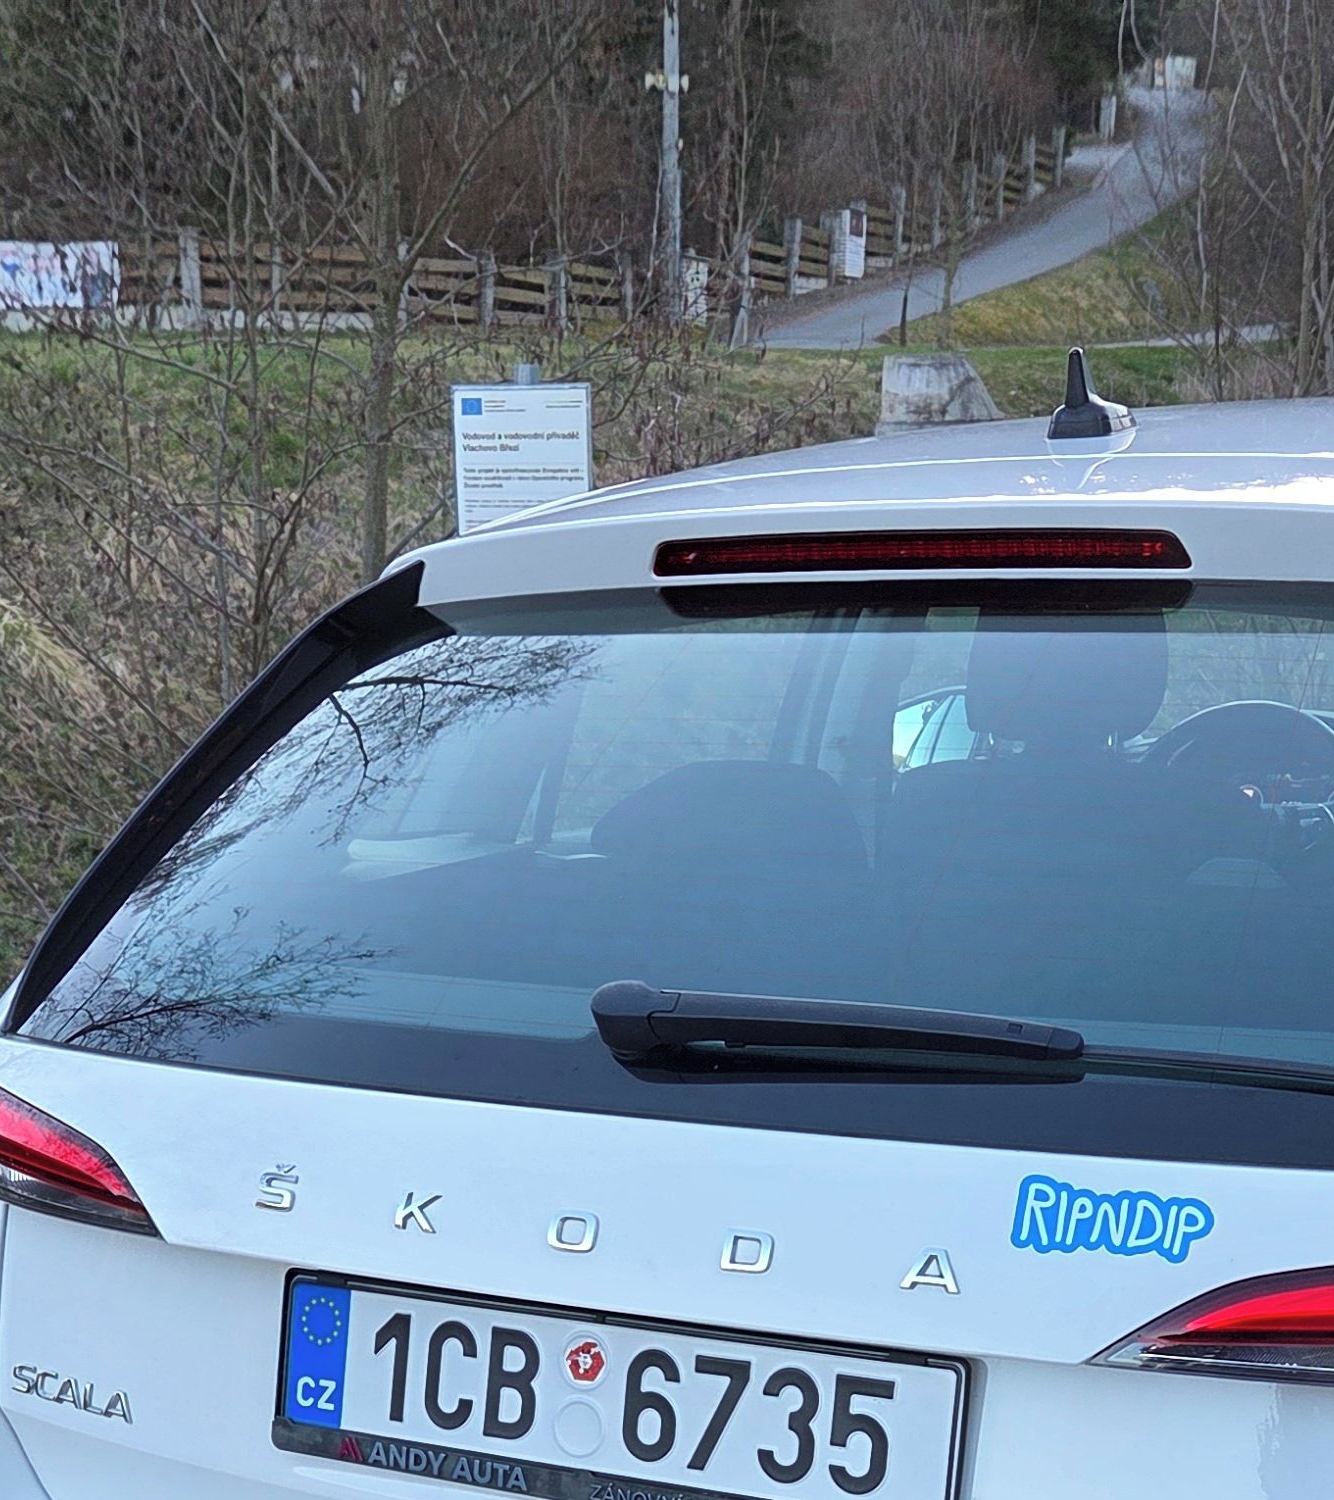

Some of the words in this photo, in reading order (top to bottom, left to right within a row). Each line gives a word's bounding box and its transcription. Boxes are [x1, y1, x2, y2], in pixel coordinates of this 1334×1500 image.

[255, 1164, 961, 1295] ŠKODA
[1019, 1182, 1206, 1256] RIPNDIP
[11, 1365, 133, 1424] SCALA
[296, 1375, 337, 1411] CZ
[374, 1312, 541, 1440] 1CB
[622, 1348, 897, 1495] 6735
[368, 1441, 447, 1476] ANDY
[452, 1456, 528, 1492] AUTA
